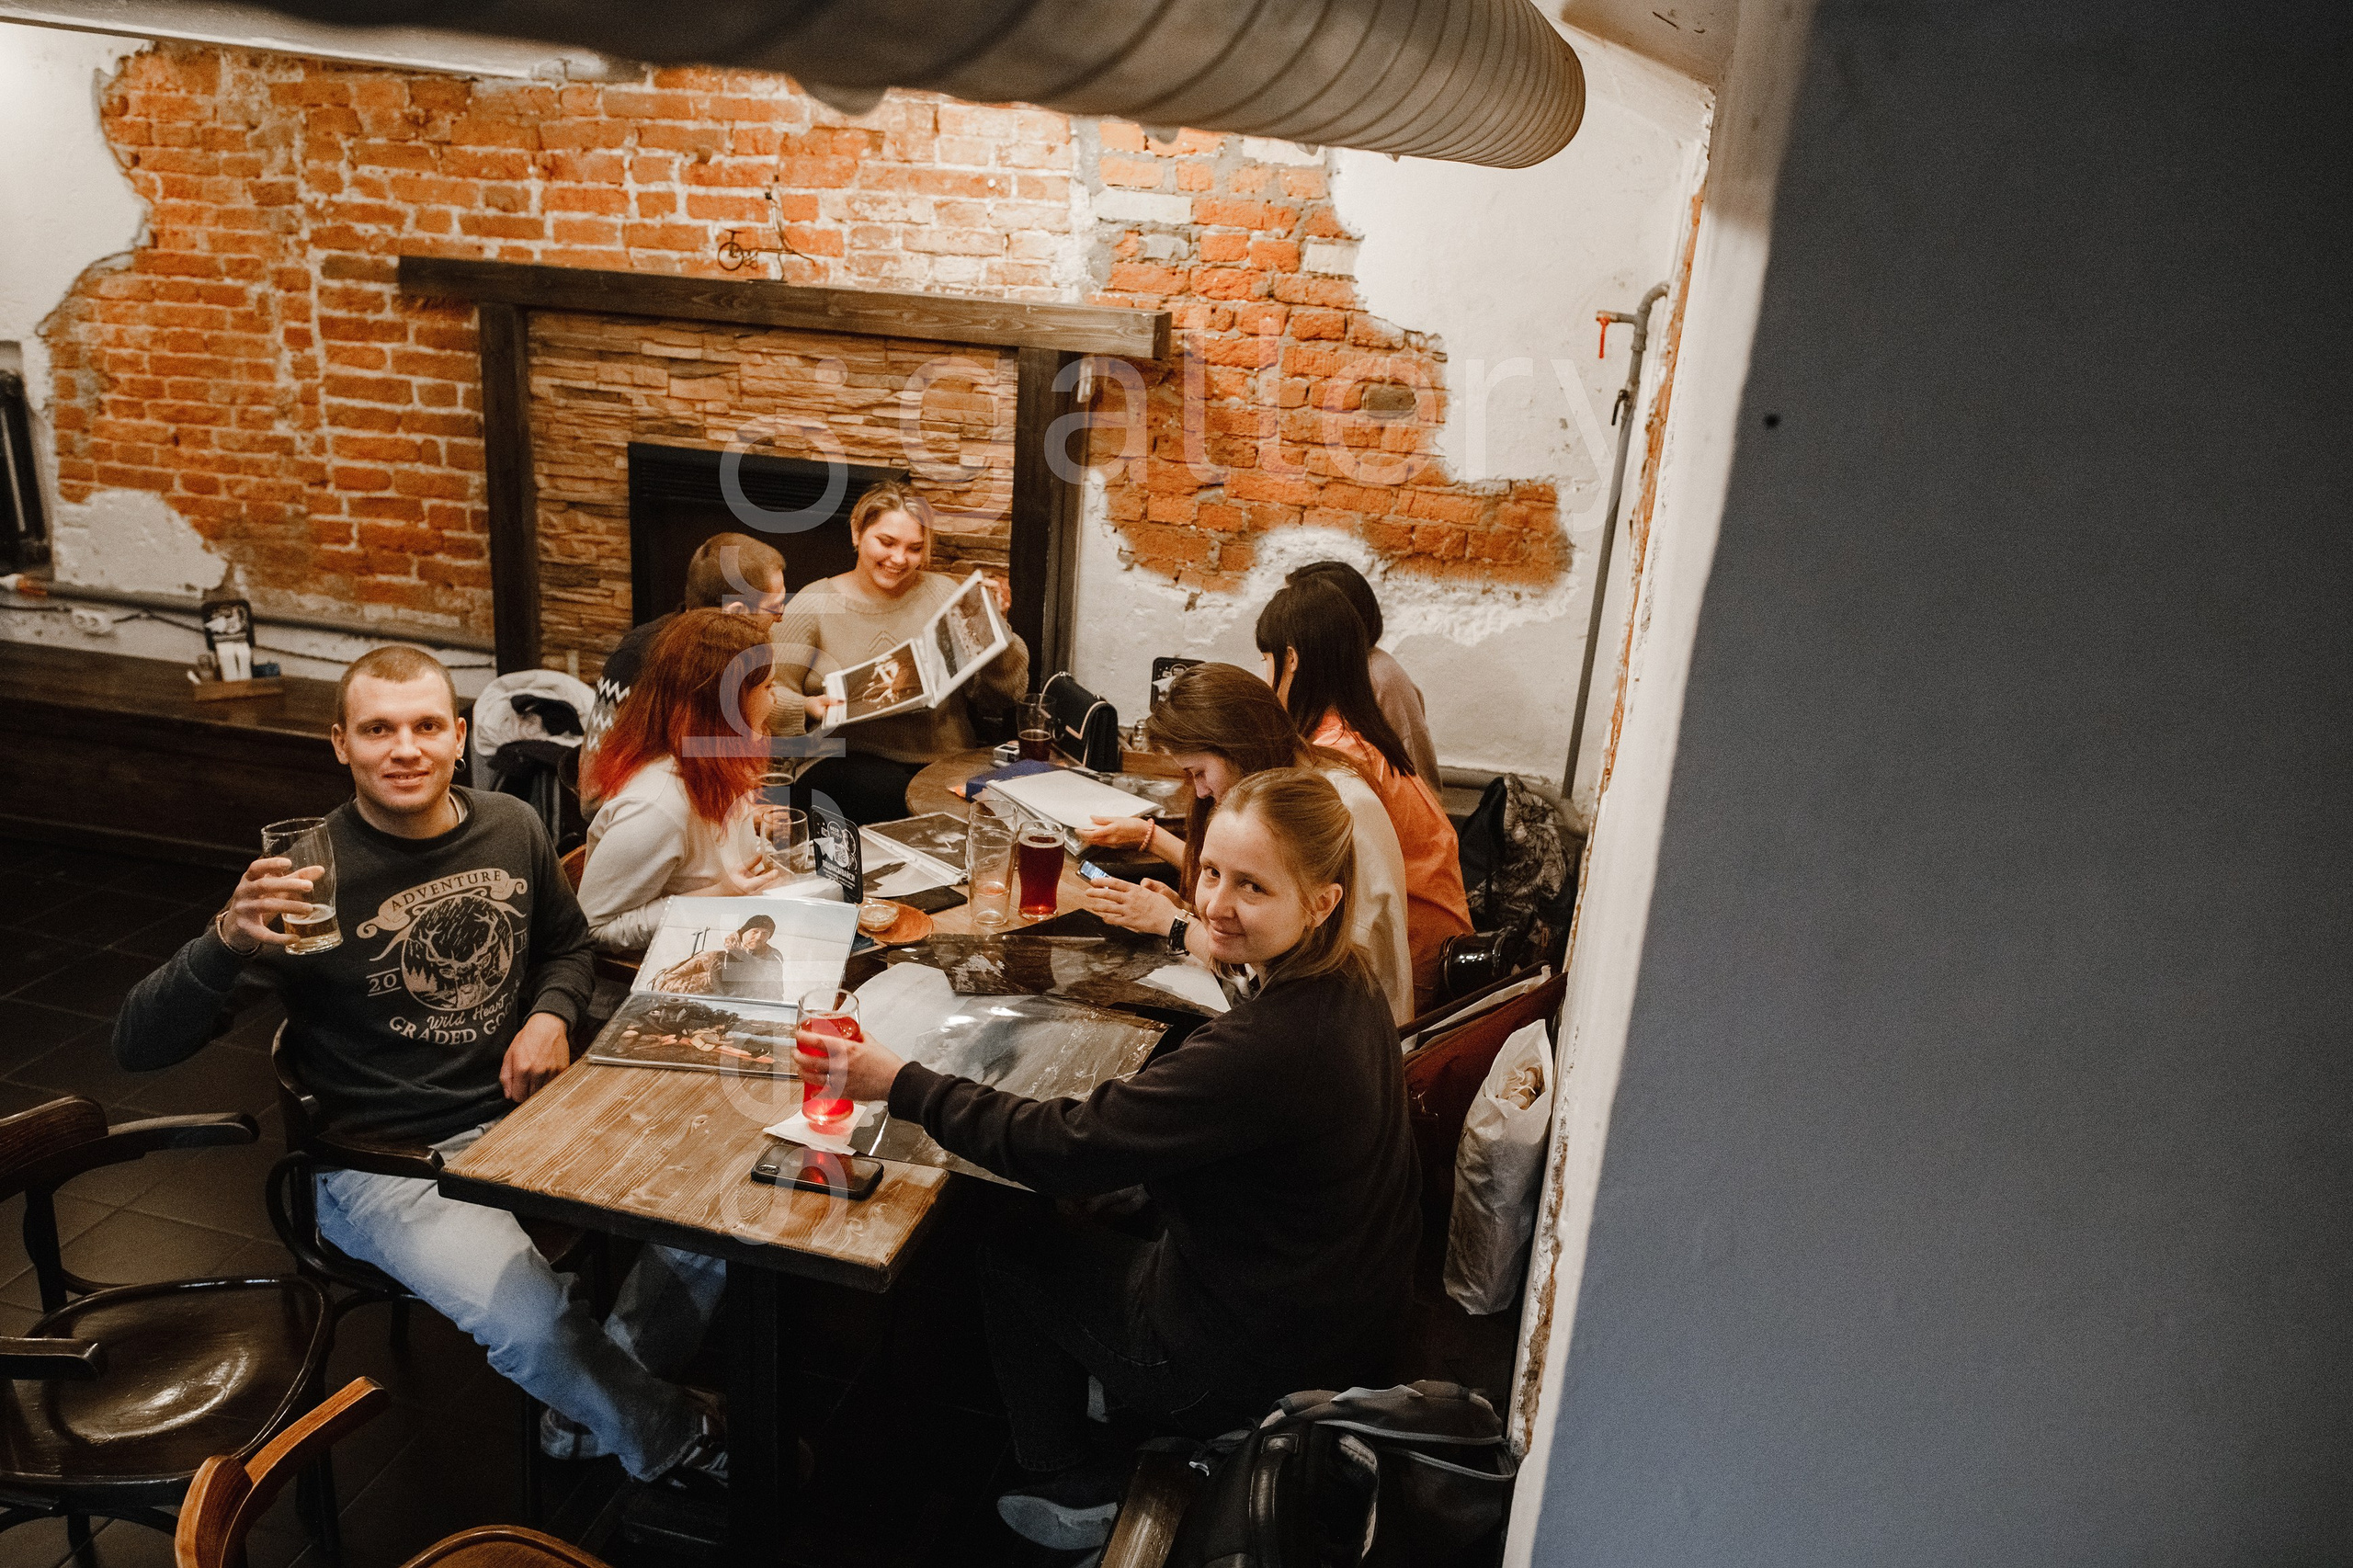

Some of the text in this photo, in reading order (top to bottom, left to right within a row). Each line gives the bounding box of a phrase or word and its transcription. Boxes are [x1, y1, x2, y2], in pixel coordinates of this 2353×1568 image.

[391, 870, 502, 912] ADVENTURE
[369, 973, 397, 994] 20
[426, 993, 508, 1030] Wild Heart
[389, 1016, 477, 1045] GRADED
